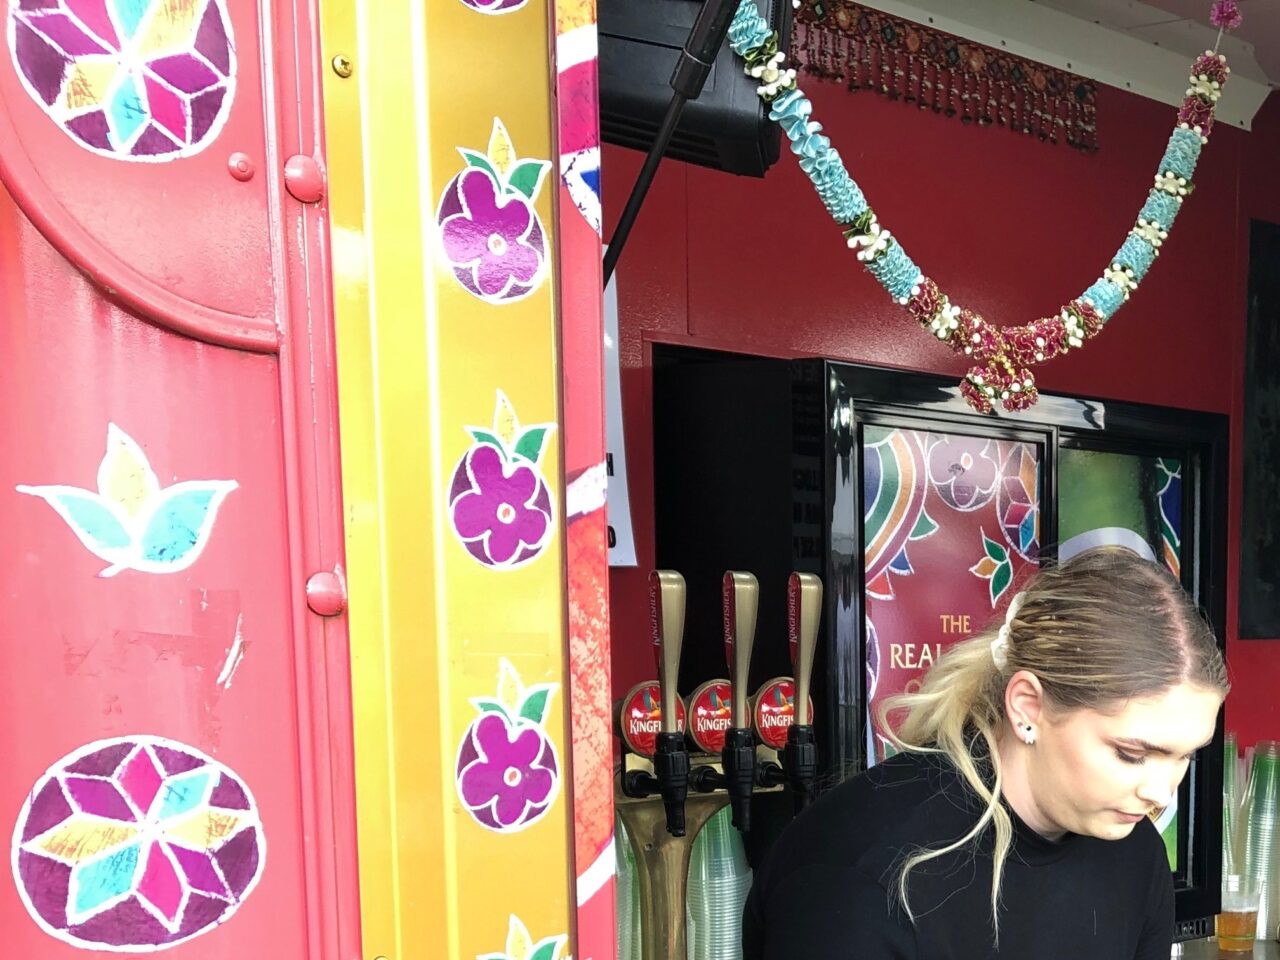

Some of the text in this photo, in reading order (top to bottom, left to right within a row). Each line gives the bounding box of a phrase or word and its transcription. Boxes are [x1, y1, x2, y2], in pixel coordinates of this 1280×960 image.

[940, 615, 972, 633] THE
[630, 719, 685, 735] KINGFIR
[697, 717, 732, 732] KINGFIS
